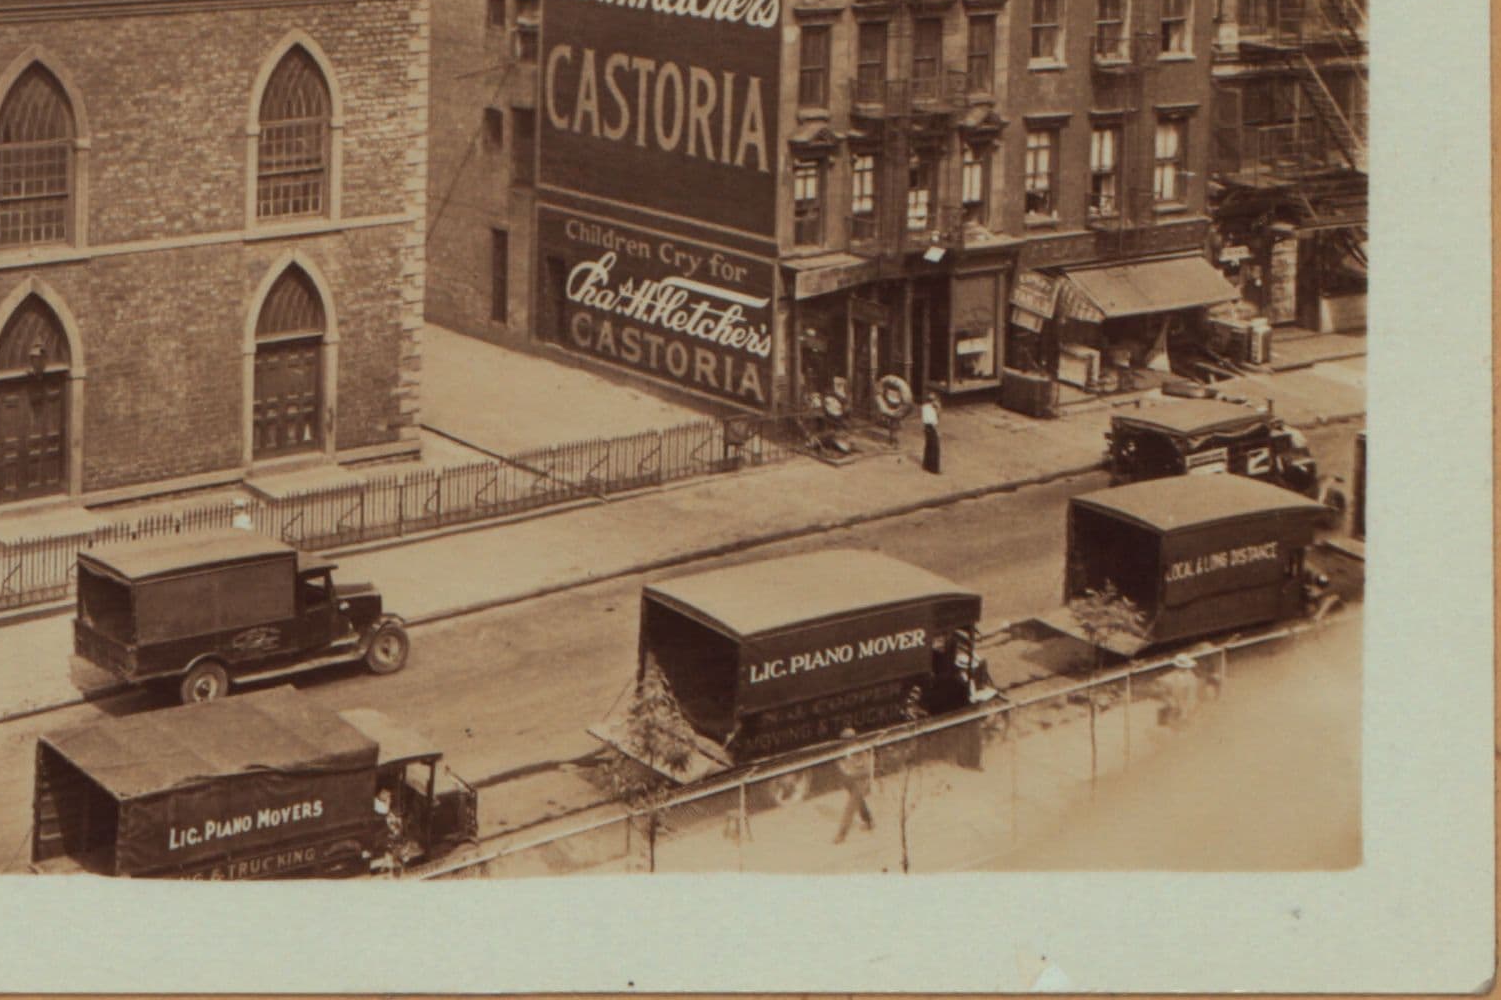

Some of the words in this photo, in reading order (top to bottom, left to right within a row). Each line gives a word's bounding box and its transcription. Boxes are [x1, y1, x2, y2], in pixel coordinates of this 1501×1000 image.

[546, 45, 770, 173] CASTORIA
[565, 219, 651, 258] Children
[659, 242, 702, 277] Cry
[709, 253, 747, 283] for
[571, 312, 765, 403] CASTORIA
[750, 664, 787, 683] LIC.
[790, 645, 853, 674] PIANO
[859, 629, 925, 658] MOVER
[204, 815, 252, 841] PIANO
[256, 800, 324, 829] MOVERS
[228, 847, 316, 879] TRUCKING
